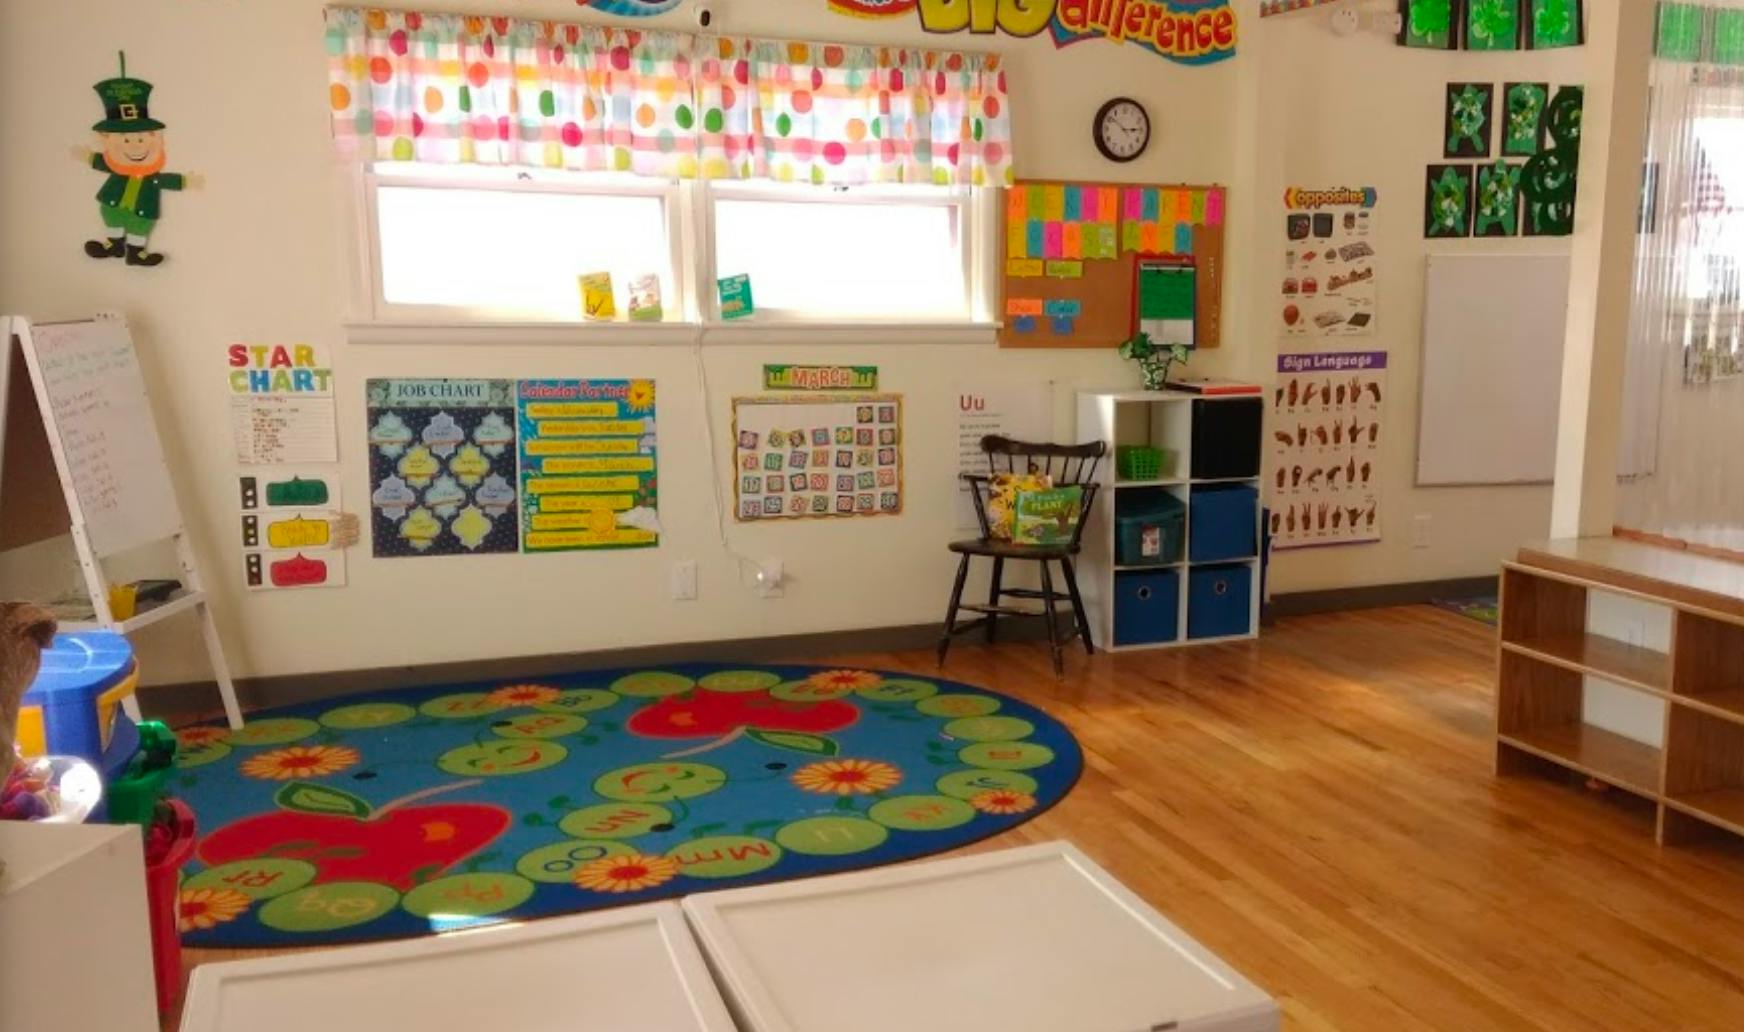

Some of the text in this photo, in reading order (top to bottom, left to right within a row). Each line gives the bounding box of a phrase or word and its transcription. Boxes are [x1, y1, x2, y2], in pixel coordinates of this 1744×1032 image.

[1295, 188, 1365, 209] opposites
[228, 343, 317, 369] STAR
[1283, 354, 1372, 372] Sign Language
[228, 369, 332, 393] CHART
[791, 366, 850, 390] MARCH
[396, 382, 484, 398] JOB CHART
[520, 381, 579, 399] Calendar
[960, 394, 985, 411] Uu
[585, 808, 652, 834] Nn
[543, 845, 608, 873] Oo
[222, 869, 284, 888] Rr
